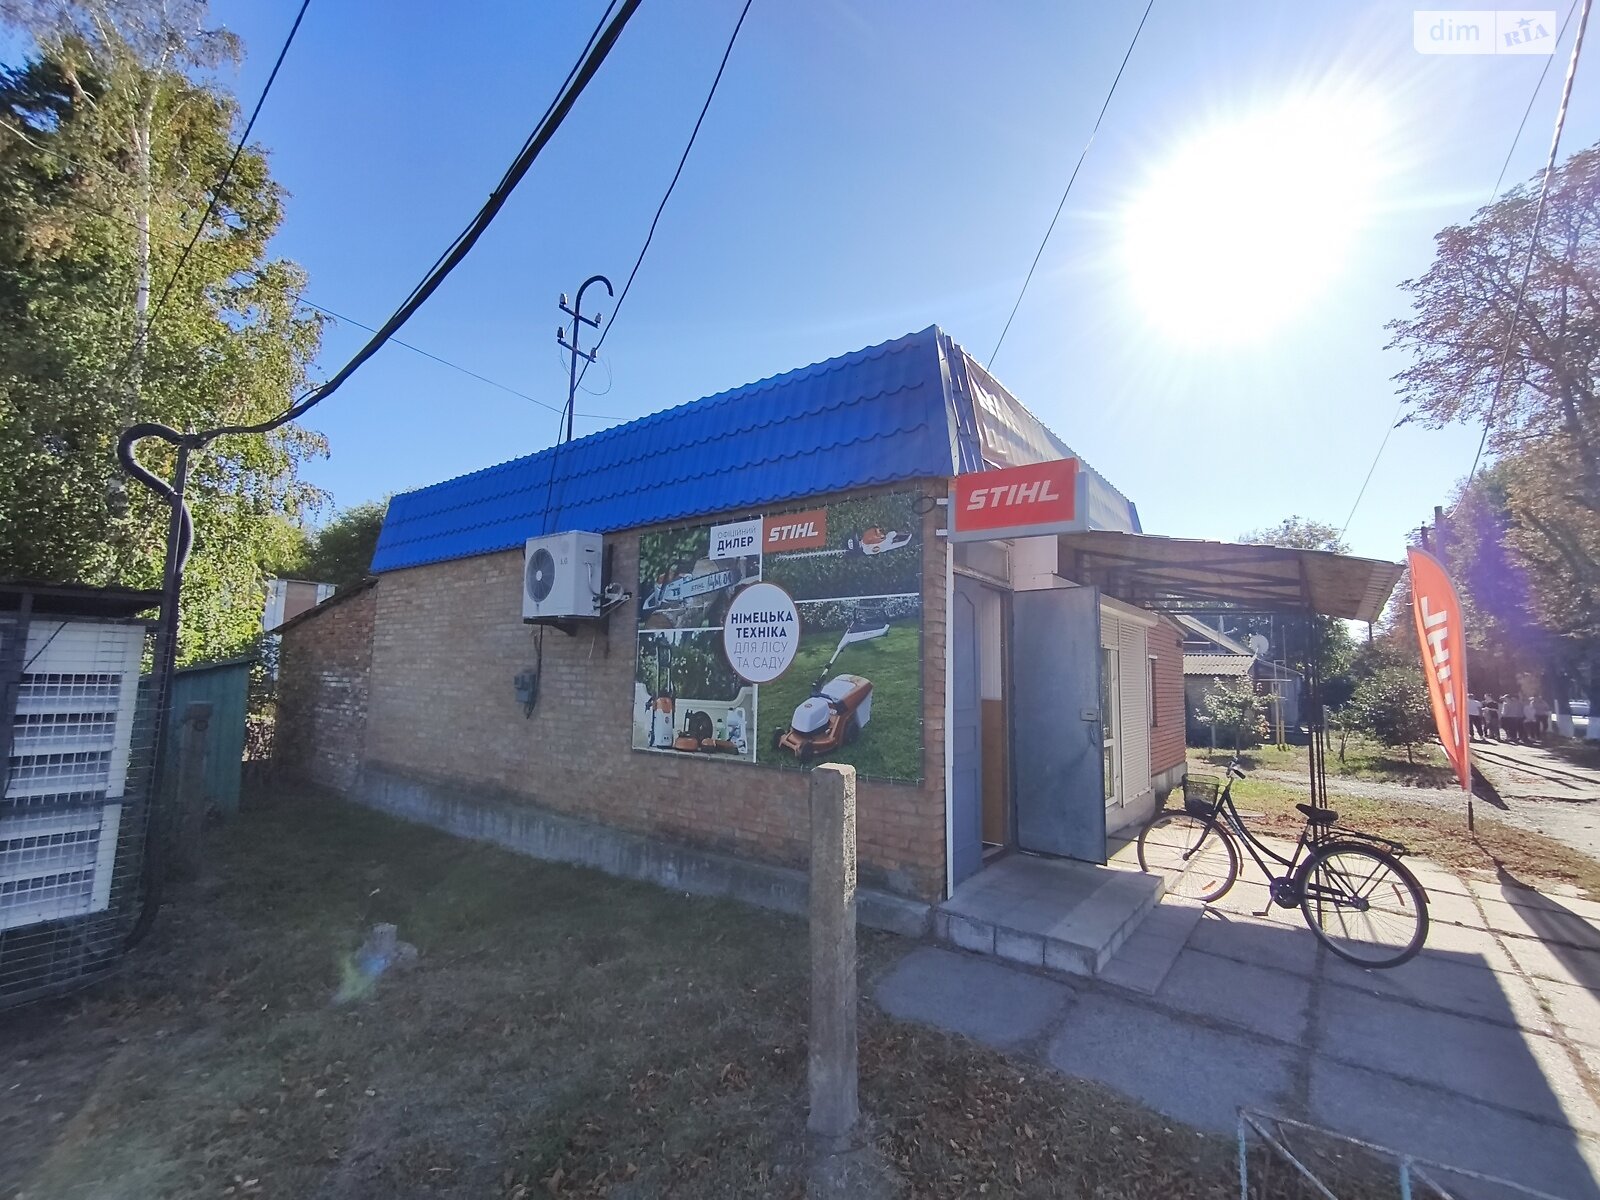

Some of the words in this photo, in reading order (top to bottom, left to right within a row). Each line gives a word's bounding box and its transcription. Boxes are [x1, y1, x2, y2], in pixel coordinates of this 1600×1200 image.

[966, 479, 1059, 511] STIHL
[768, 521, 819, 542] STIHL
[717, 536, 754, 552] ДИЛЕР
[731, 610, 794, 624] НІМЕЦЬКА
[736, 626, 787, 639] ТЕХНІКА
[734, 641, 757, 655] ДЛЯ
[760, 641, 788, 654] ЛІСУ
[737, 656, 750, 668] ТА
[752, 656, 785, 670] САДУ
